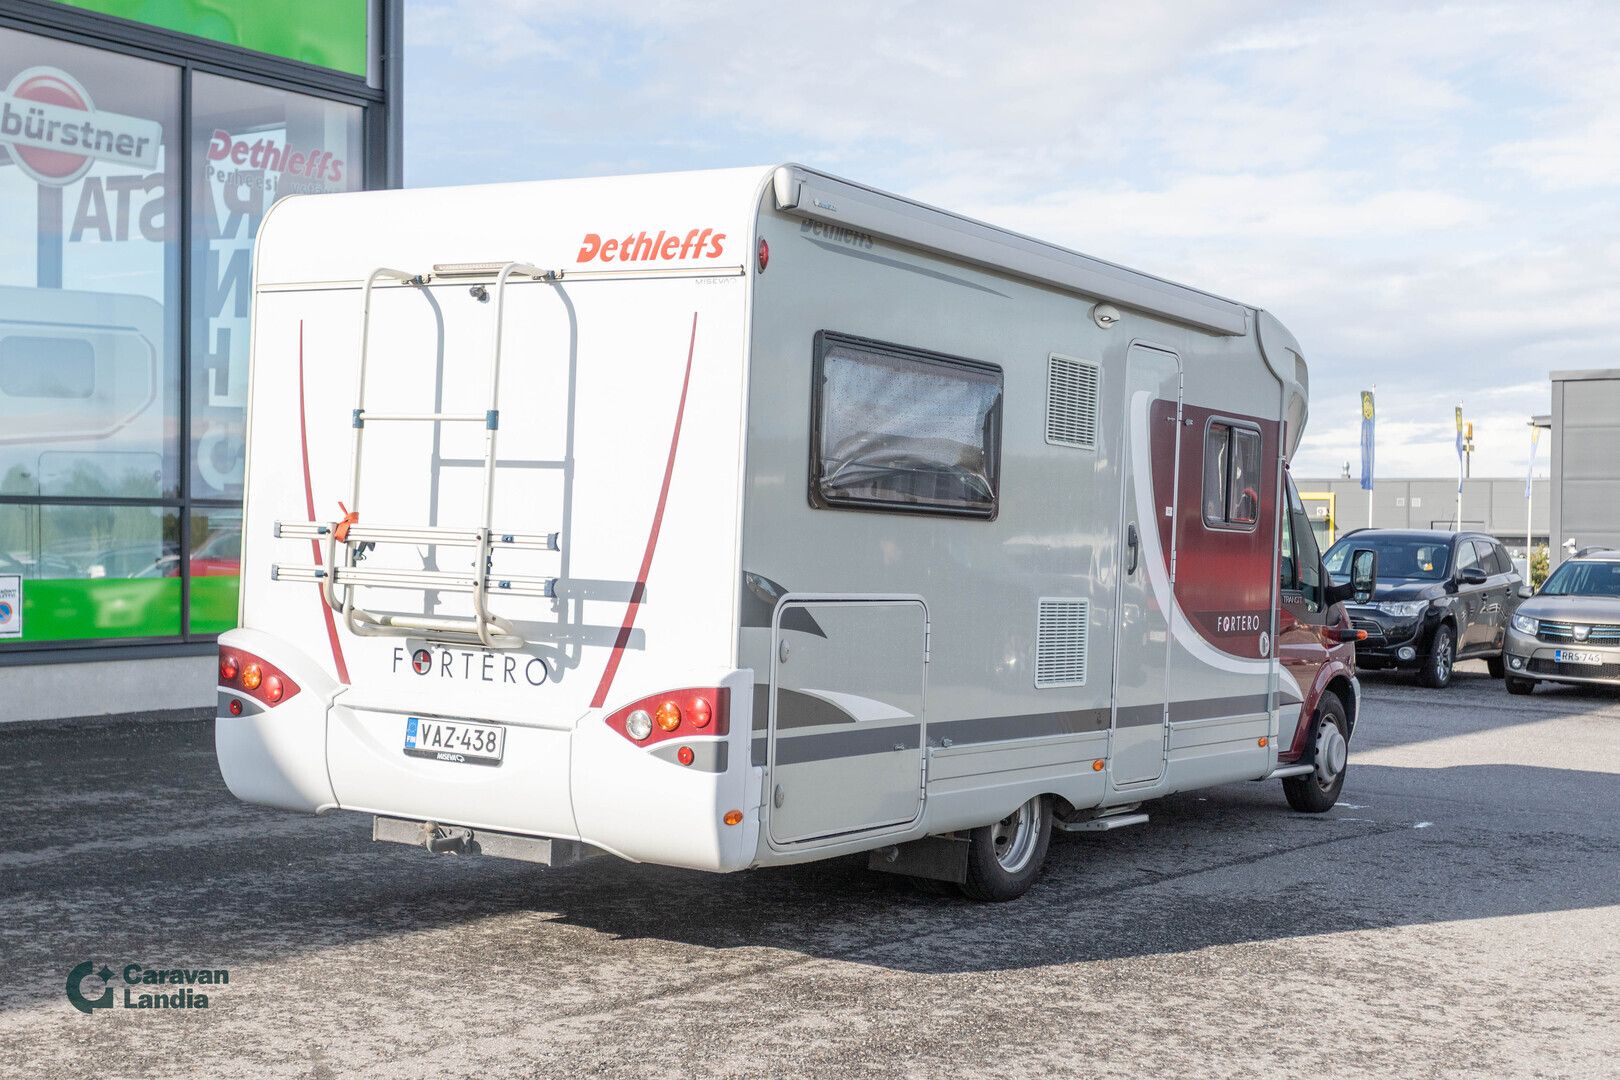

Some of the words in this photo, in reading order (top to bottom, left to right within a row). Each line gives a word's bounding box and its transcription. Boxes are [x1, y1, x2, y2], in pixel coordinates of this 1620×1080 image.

[1, 102, 149, 157] bürstner
[207, 129, 344, 182] Dethleffs
[576, 228, 726, 263] Dethleffs
[1217, 615, 1260, 632] FORTERO
[393, 647, 548, 686] FORTERO
[421, 723, 497, 753] VAZ-438
